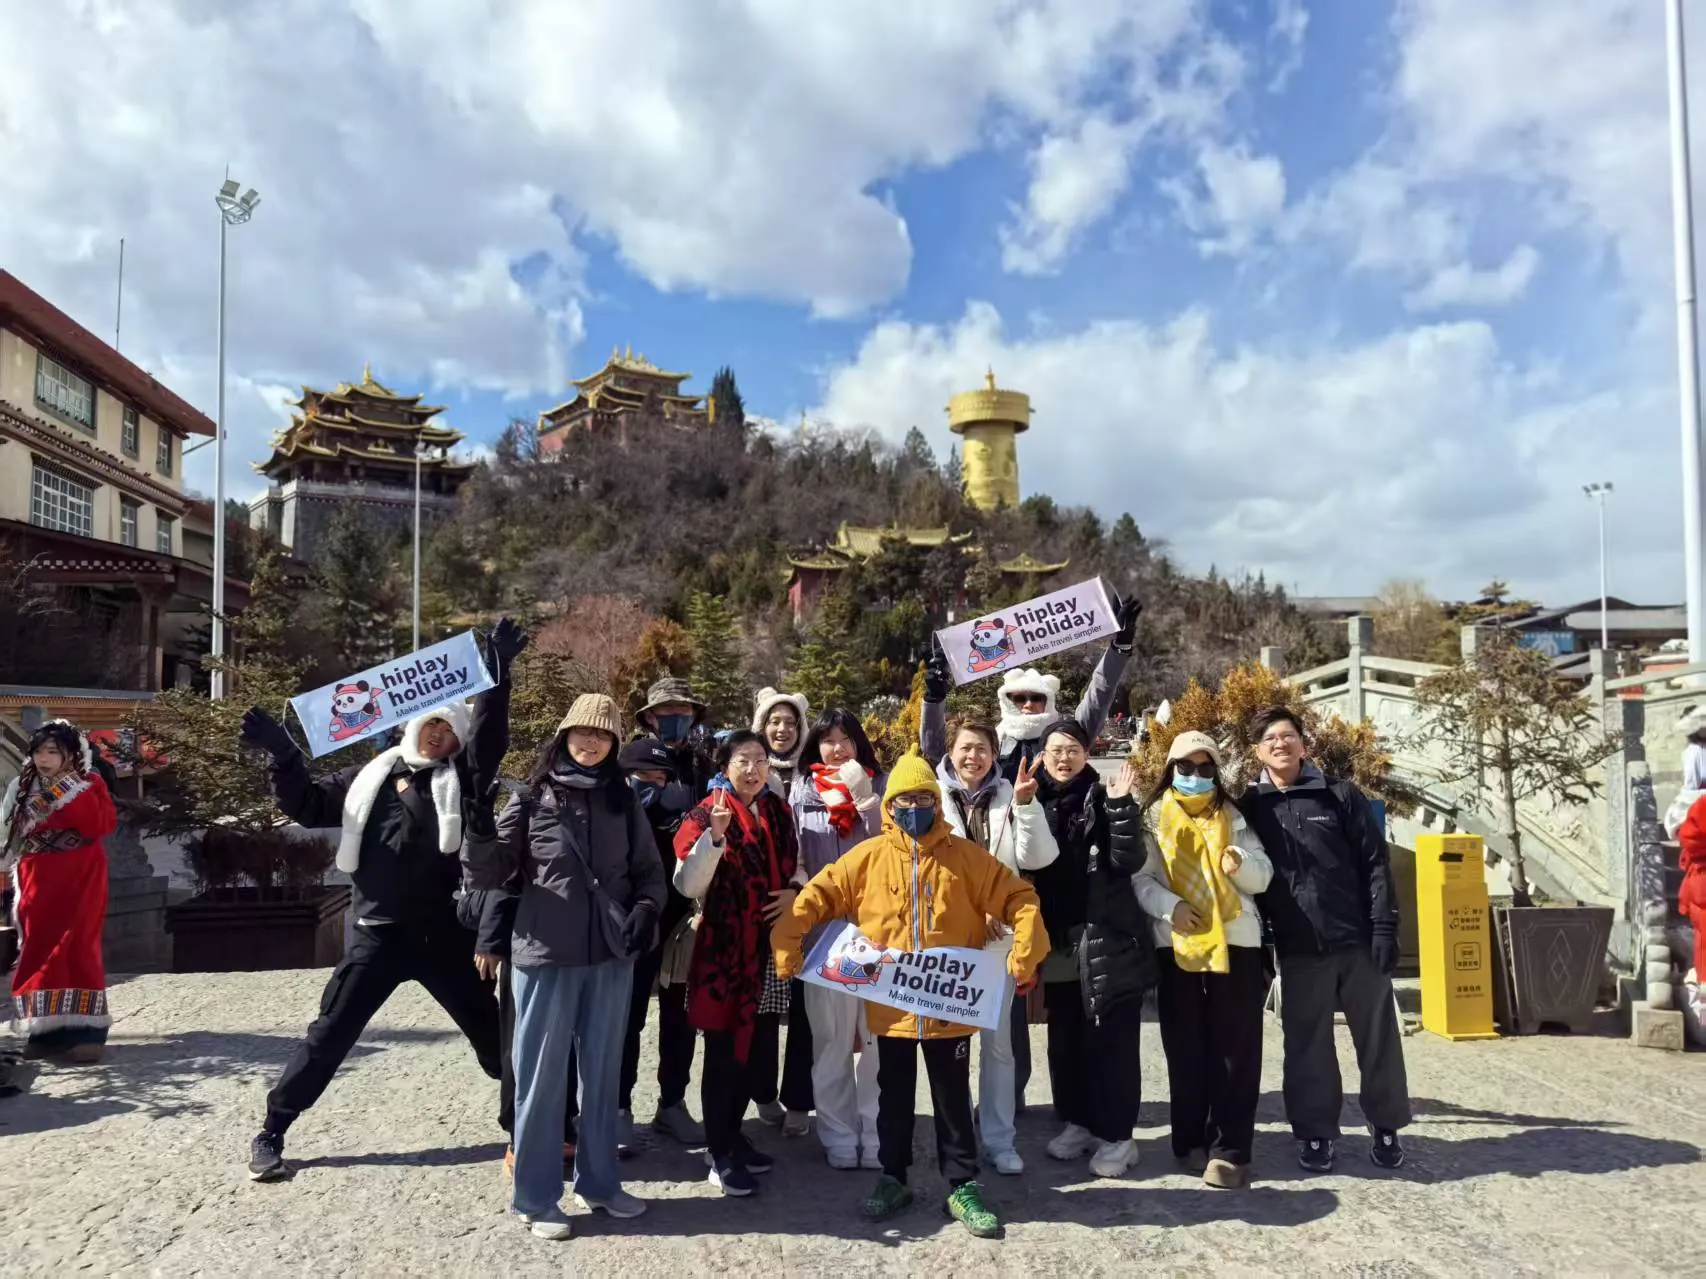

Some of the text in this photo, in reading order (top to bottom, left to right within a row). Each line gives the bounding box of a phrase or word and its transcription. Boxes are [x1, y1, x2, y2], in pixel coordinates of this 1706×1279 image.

[1014, 596, 1077, 627] hiplay
[1020, 610, 1095, 644] holiday
[1027, 624, 1103, 656] Make travel simpler
[380, 653, 448, 690] hiplay
[388, 666, 468, 707] holiday
[395, 681, 476, 718] Make travel simpler
[888, 988, 981, 1018] Make travel simpler
[892, 966, 985, 1007] holiday
